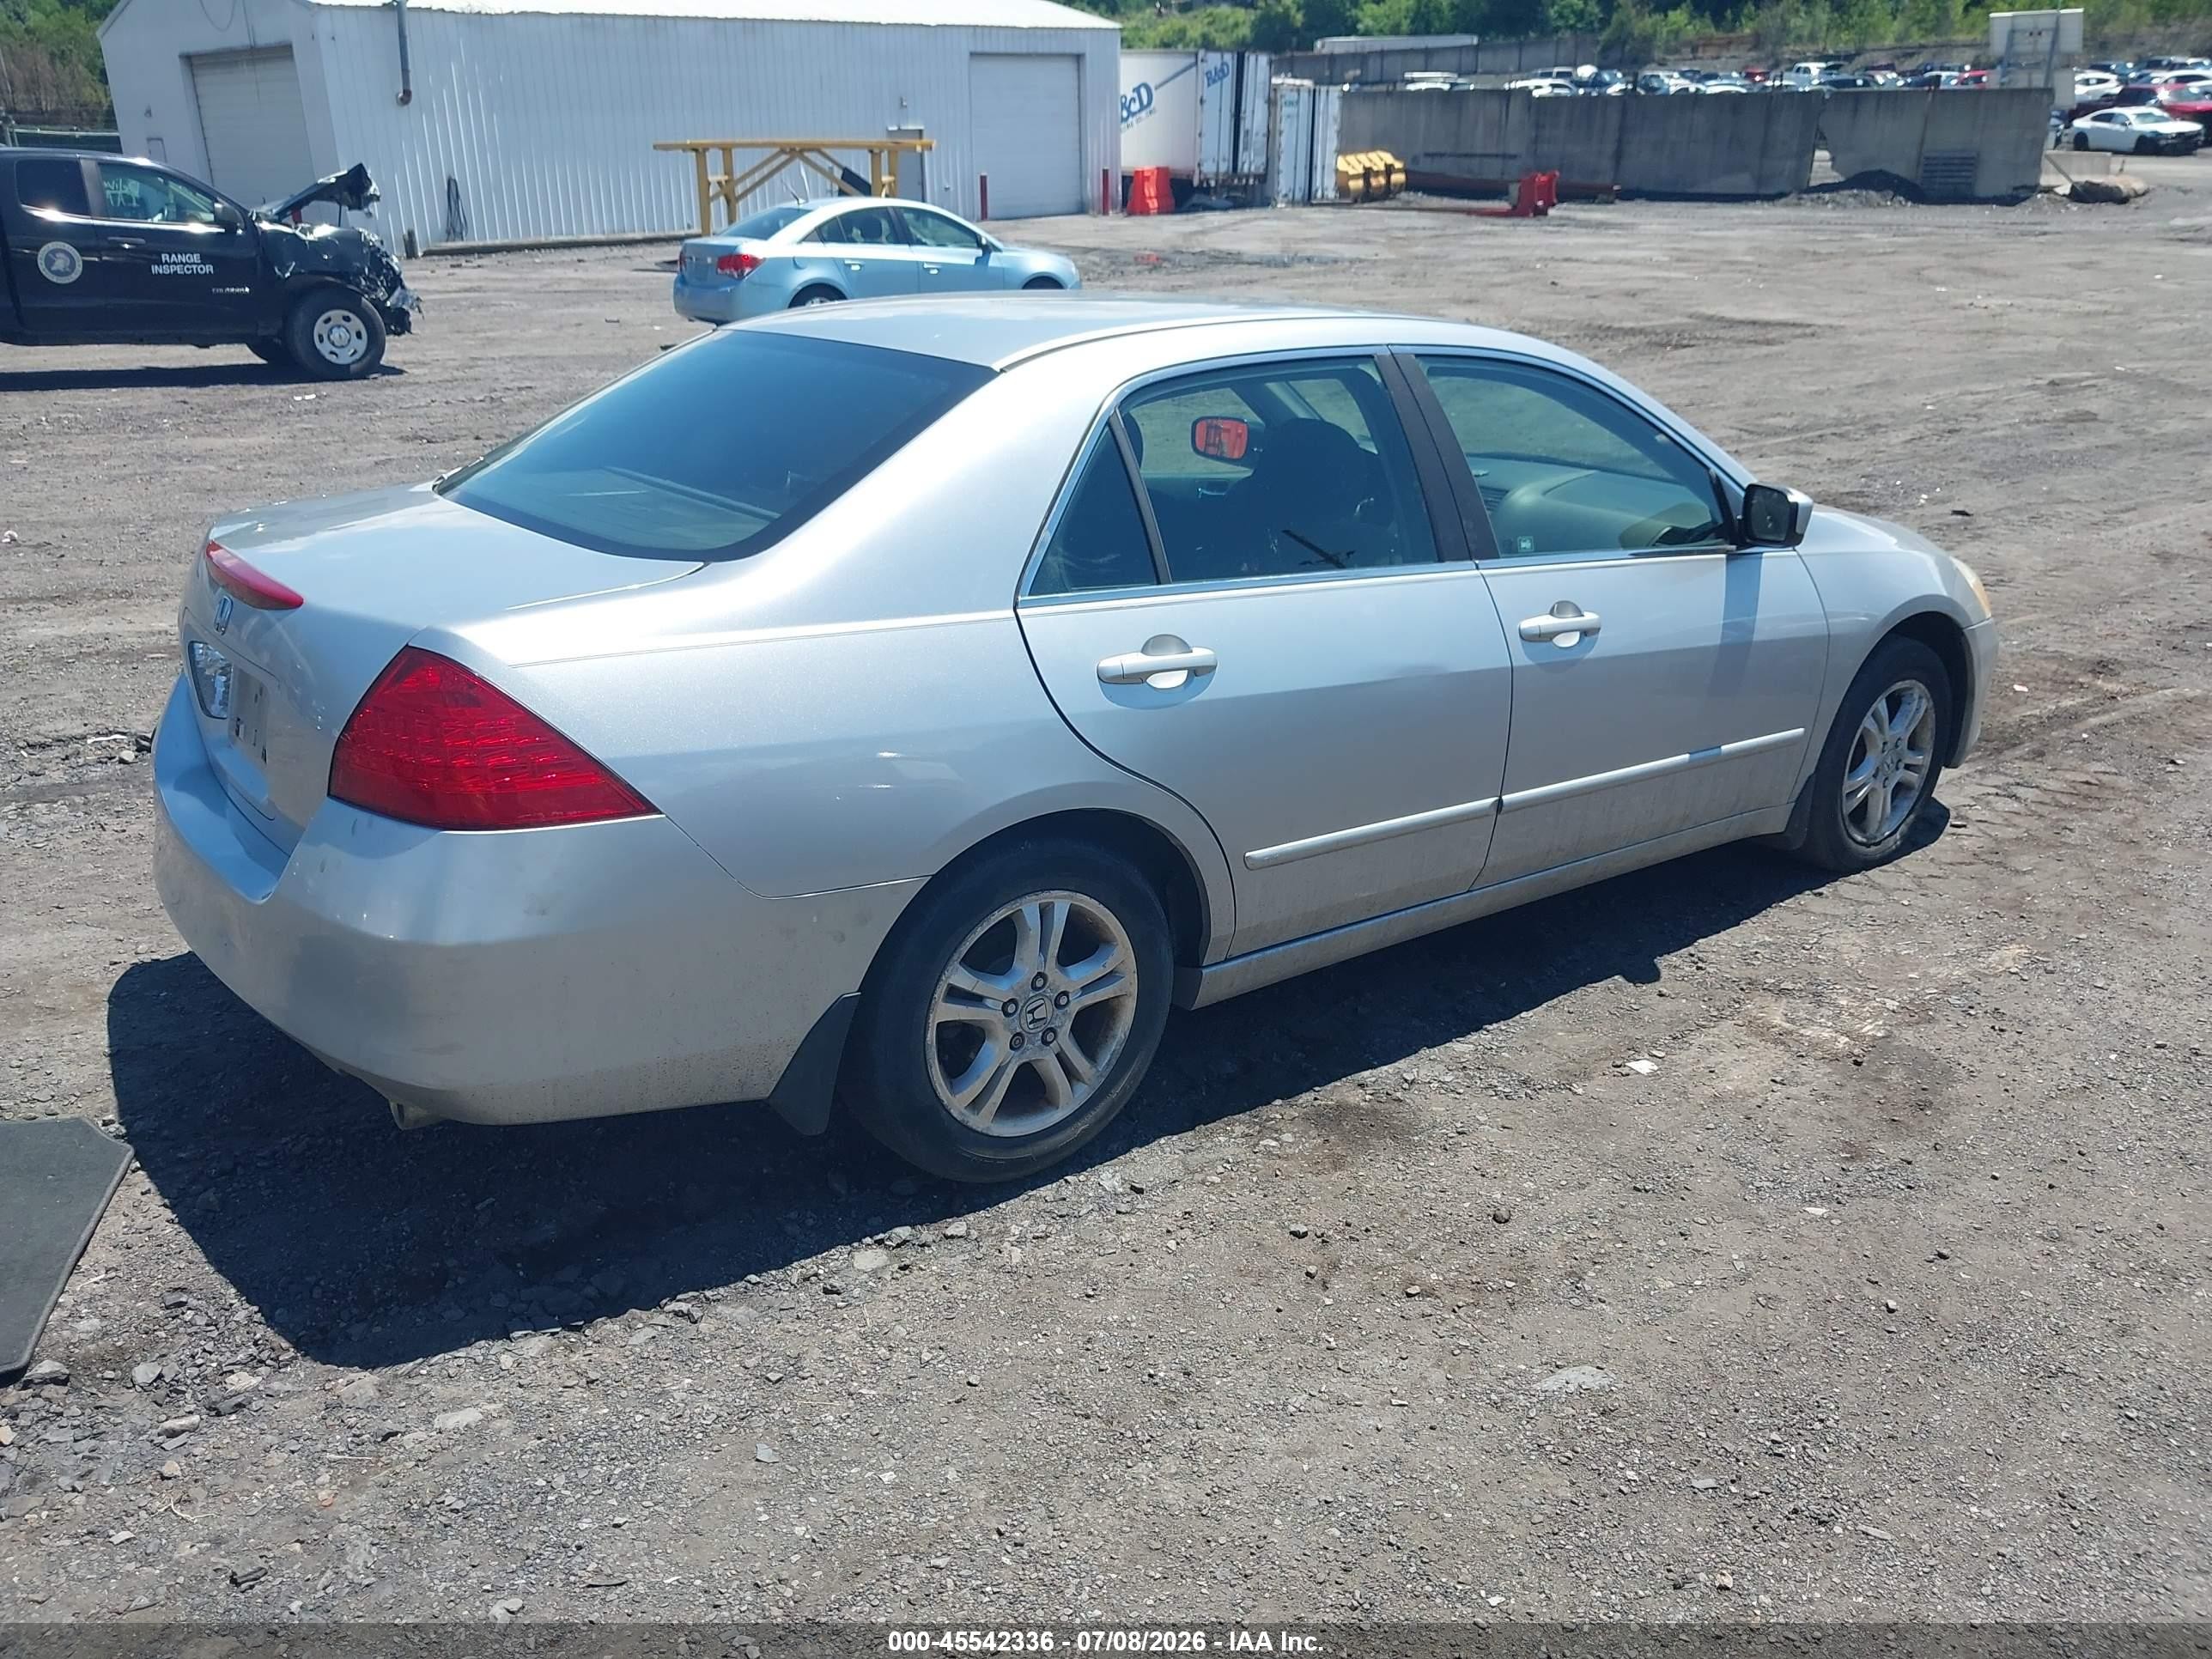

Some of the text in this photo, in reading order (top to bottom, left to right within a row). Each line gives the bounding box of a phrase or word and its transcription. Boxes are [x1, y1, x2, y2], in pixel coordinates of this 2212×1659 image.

[1120, 82, 1153, 123] &D
[161, 253, 202, 264] RANGE
[151, 264, 214, 275] INSPECTOR
